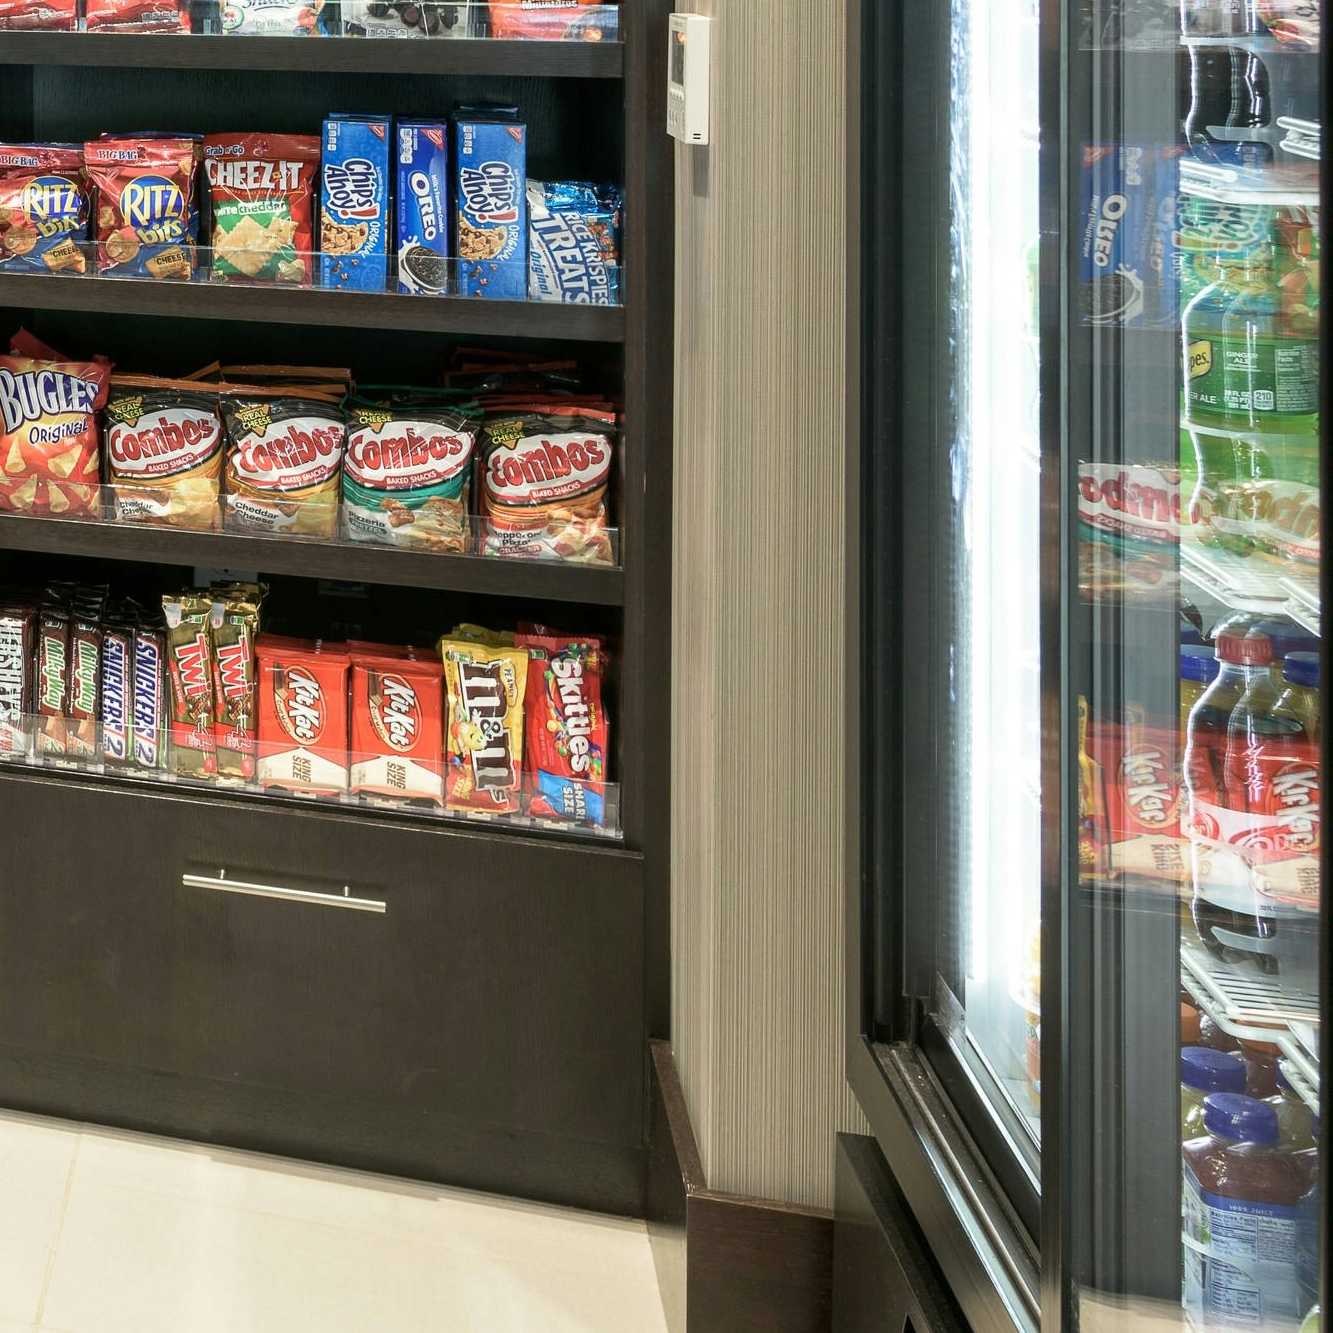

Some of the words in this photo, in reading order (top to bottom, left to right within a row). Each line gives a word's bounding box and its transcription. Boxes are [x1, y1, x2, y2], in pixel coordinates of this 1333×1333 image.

[521, 0, 578, 10] Miniatures
[0, 155, 19, 165] BIG
[19, 156, 38, 166] BAG
[97, 149, 118, 160] BIG
[118, 150, 137, 160] BAG
[232, 145, 244, 156] Go
[342, 158, 375, 212] Chips
[480, 161, 513, 214] Chips
[23, 185, 78, 224] RITZ
[124, 184, 180, 227] RITZ
[410, 170, 436, 241] OREO
[136, 220, 183, 244] bits
[361, 221, 381, 259] ORIGINAL
[496, 224, 520, 261] ORIGINAL
[564, 211, 591, 244] RICE
[534, 216, 590, 306] TREATS
[535, 249, 550, 295] Original
[1199, 395, 1217, 404] ALE
[1255, 392, 1272, 401] 210
[111, 417, 211, 462] Combos
[235, 425, 342, 474] Combos
[349, 428, 463, 471] Combos
[147, 461, 169, 472] BAKED
[170, 453, 194, 469] SNACKS
[280, 473, 300, 484] BAKED
[301, 467, 326, 480] SNACKS
[386, 474, 409, 484] BAKED
[409, 470, 437, 482] SNACKS
[492, 440, 605, 487] Combos
[532, 488, 553, 498] BAKED
[554, 482, 580, 495] SNACKS
[235, 502, 278, 519] Cheddar
[103, 635, 124, 735] SNICKERS
[136, 635, 157, 740] SNICKERS
[504, 666, 516, 700] PEANUT
[551, 657, 590, 773] Skittles
[292, 755, 302, 783] SIZE
[302, 757, 312, 783] KING
[386, 761, 396, 789] SIZE
[396, 764, 406, 790] KING
[562, 784, 573, 814] SIZE
